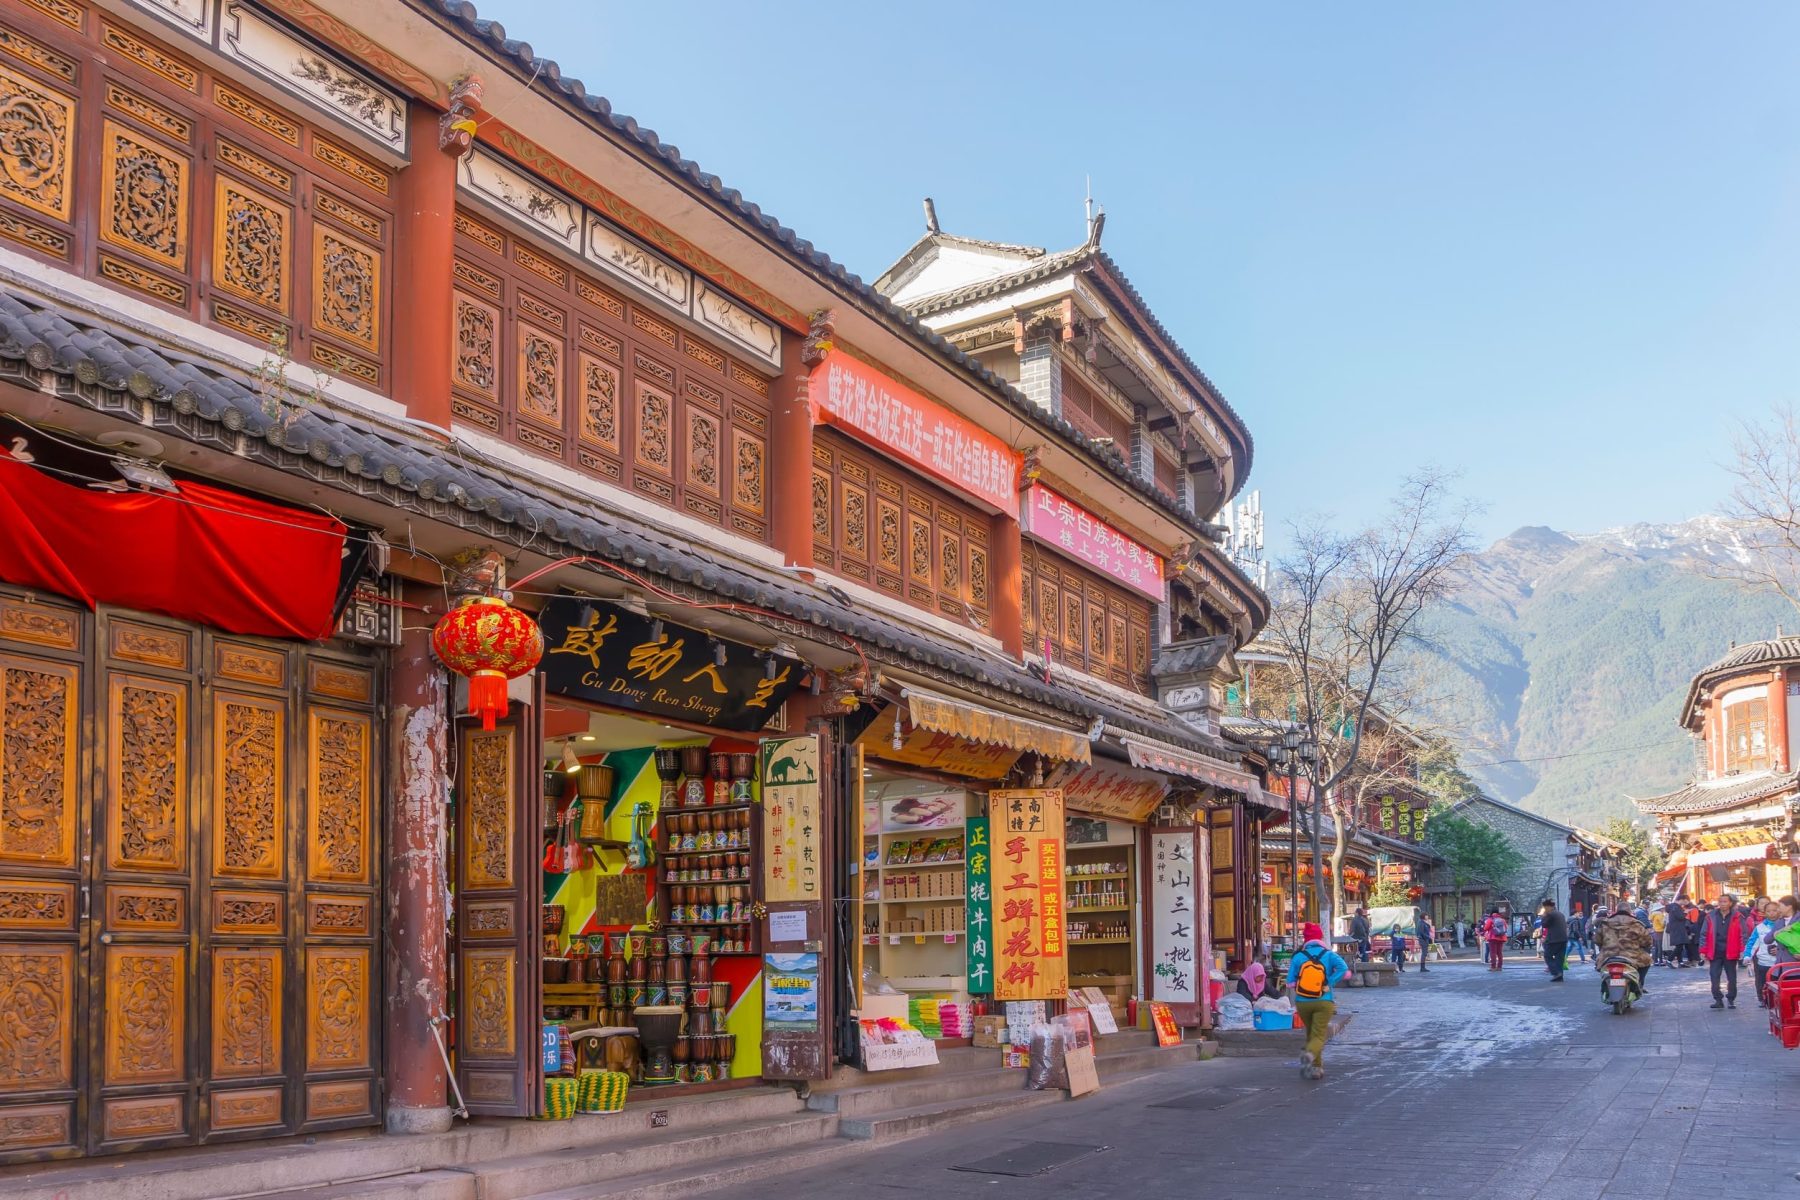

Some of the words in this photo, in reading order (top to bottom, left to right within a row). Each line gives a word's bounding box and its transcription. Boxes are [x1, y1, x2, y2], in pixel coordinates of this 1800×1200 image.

[1038, 488, 1158, 575] 正宗白族农家菜
[549, 608, 791, 709] 鼓动人生
[581, 671, 605, 689] Gu
[608, 677, 649, 704] Dong
[652, 688, 680, 708] Ren
[682, 695, 722, 718] Sheng
[1010, 798, 1041, 814] 云南
[1010, 814, 1041, 832] 特产
[970, 826, 990, 988] 正宗牦牛肉干
[1000, 836, 1040, 990] 手工鲜花饼
[1042, 843, 1060, 954] 买五送一或五盒包邮
[1169, 843, 1192, 992] 文山三七批发
